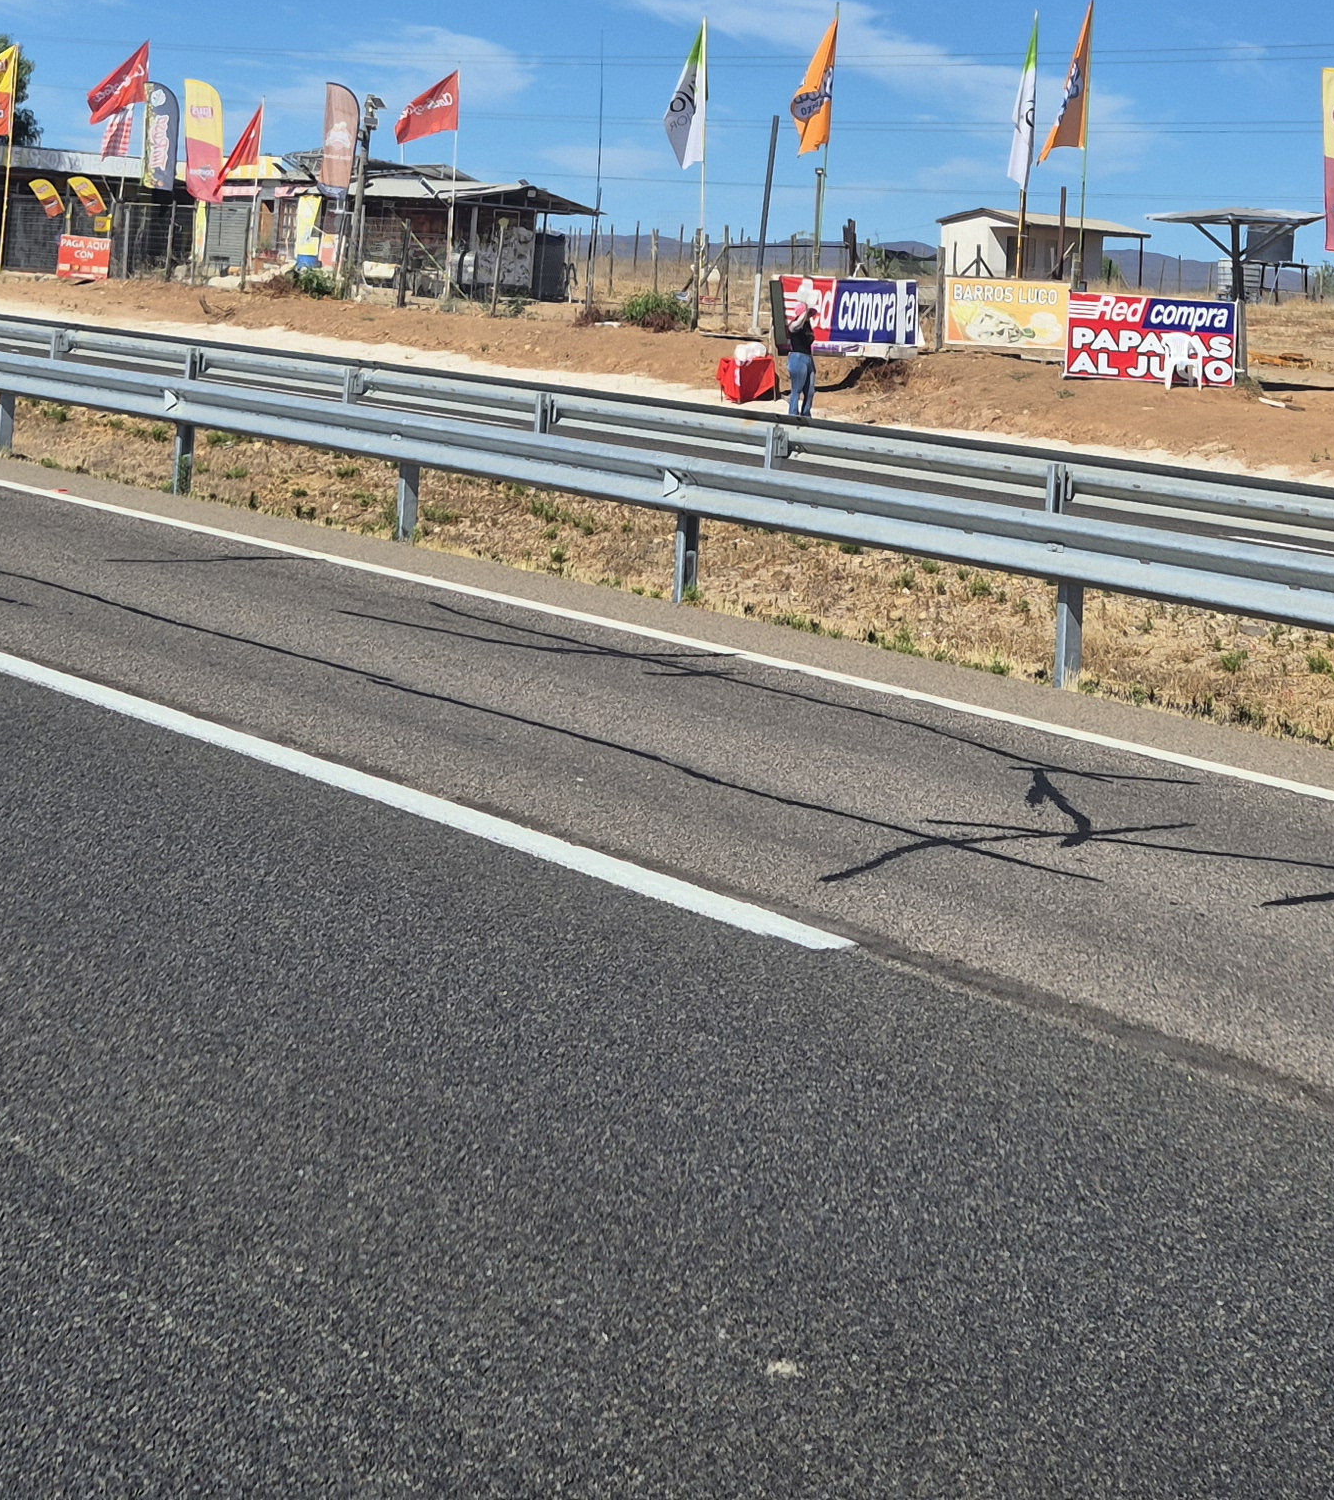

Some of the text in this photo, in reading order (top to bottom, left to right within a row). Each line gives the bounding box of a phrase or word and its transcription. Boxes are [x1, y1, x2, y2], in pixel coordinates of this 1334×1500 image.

[60, 238, 85, 249] PAGA
[74, 250, 94, 259] CON
[953, 283, 1059, 306] BARROS LUCO
[838, 290, 896, 343] compra
[1093, 295, 1229, 332] Red compra
[1068, 351, 1119, 376] AL
